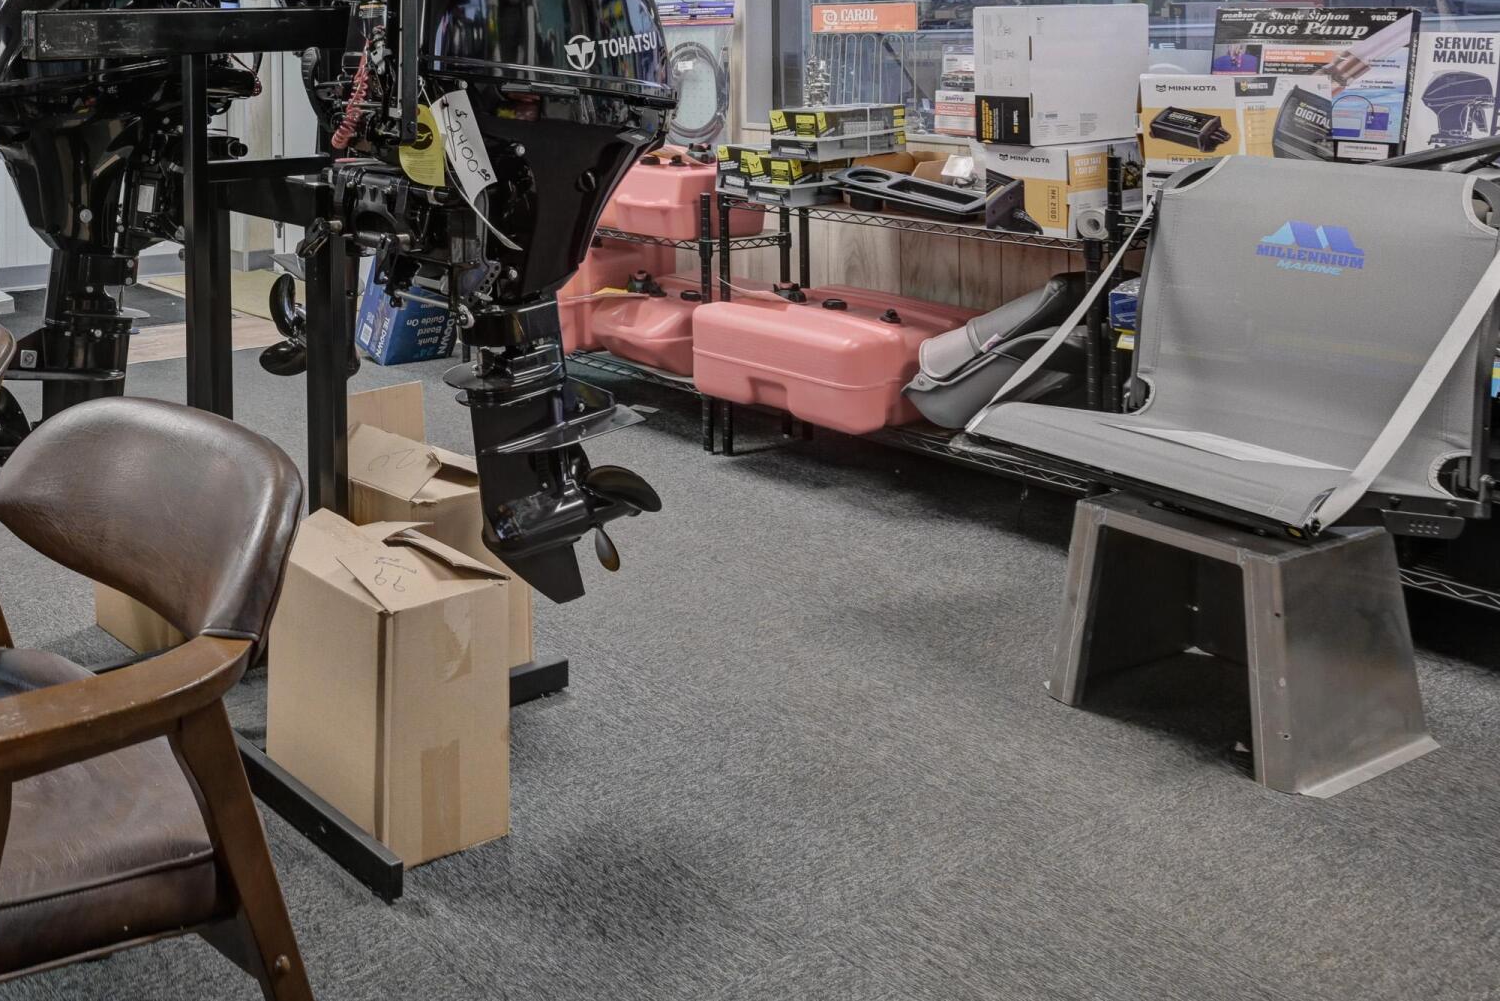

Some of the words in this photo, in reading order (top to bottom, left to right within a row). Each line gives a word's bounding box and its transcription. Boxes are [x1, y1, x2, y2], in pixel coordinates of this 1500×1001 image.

[841, 8, 878, 21] CAROL
[1269, 11, 1304, 21] Shake
[1307, 9, 1349, 23] Siphon
[1248, 21, 1299, 35] Hose
[1303, 21, 1369, 39] Pump
[598, 32, 658, 58] TOHATSU
[1434, 36, 1495, 51] SERVICE
[1433, 50, 1496, 65] MANUAL
[1193, 84, 1217, 92] KOTA
[1168, 113, 1197, 123] DIGITAL
[1294, 107, 1332, 129] DIGITAL
[1256, 244, 1365, 270] MILLENNIUM
[1276, 260, 1343, 276] MARINE
[383, 317, 391, 330] TIE
[406, 319, 419, 327] On
[421, 315, 445, 326] Guide
[417, 326, 442, 336] Board
[436, 319, 455, 355] DOWN
[418, 336, 439, 347] Bunk
